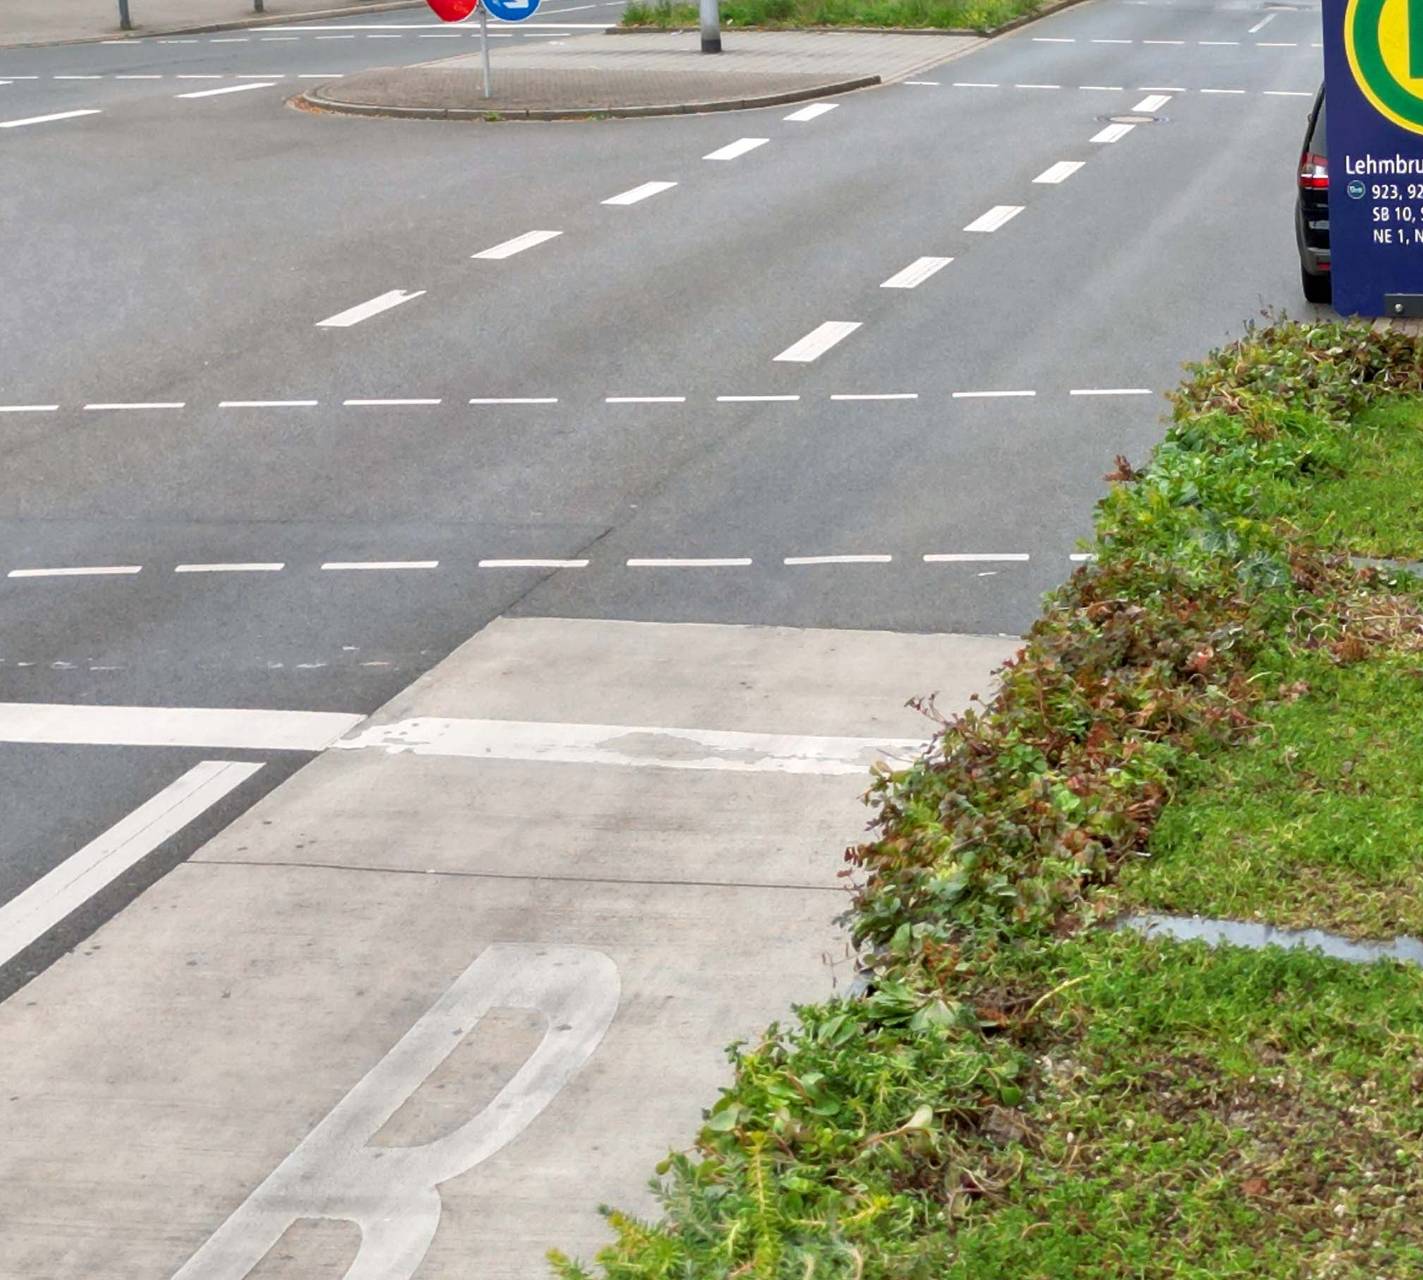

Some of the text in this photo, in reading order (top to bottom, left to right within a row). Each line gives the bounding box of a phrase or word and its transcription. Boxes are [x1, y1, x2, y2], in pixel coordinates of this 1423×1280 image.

[1371, 184, 1402, 200] 923,
[1372, 206, 1390, 221] SB
[1394, 206, 1416, 223] 10,
[1373, 229, 1392, 243] NE
[1397, 229, 1410, 245] 1,
